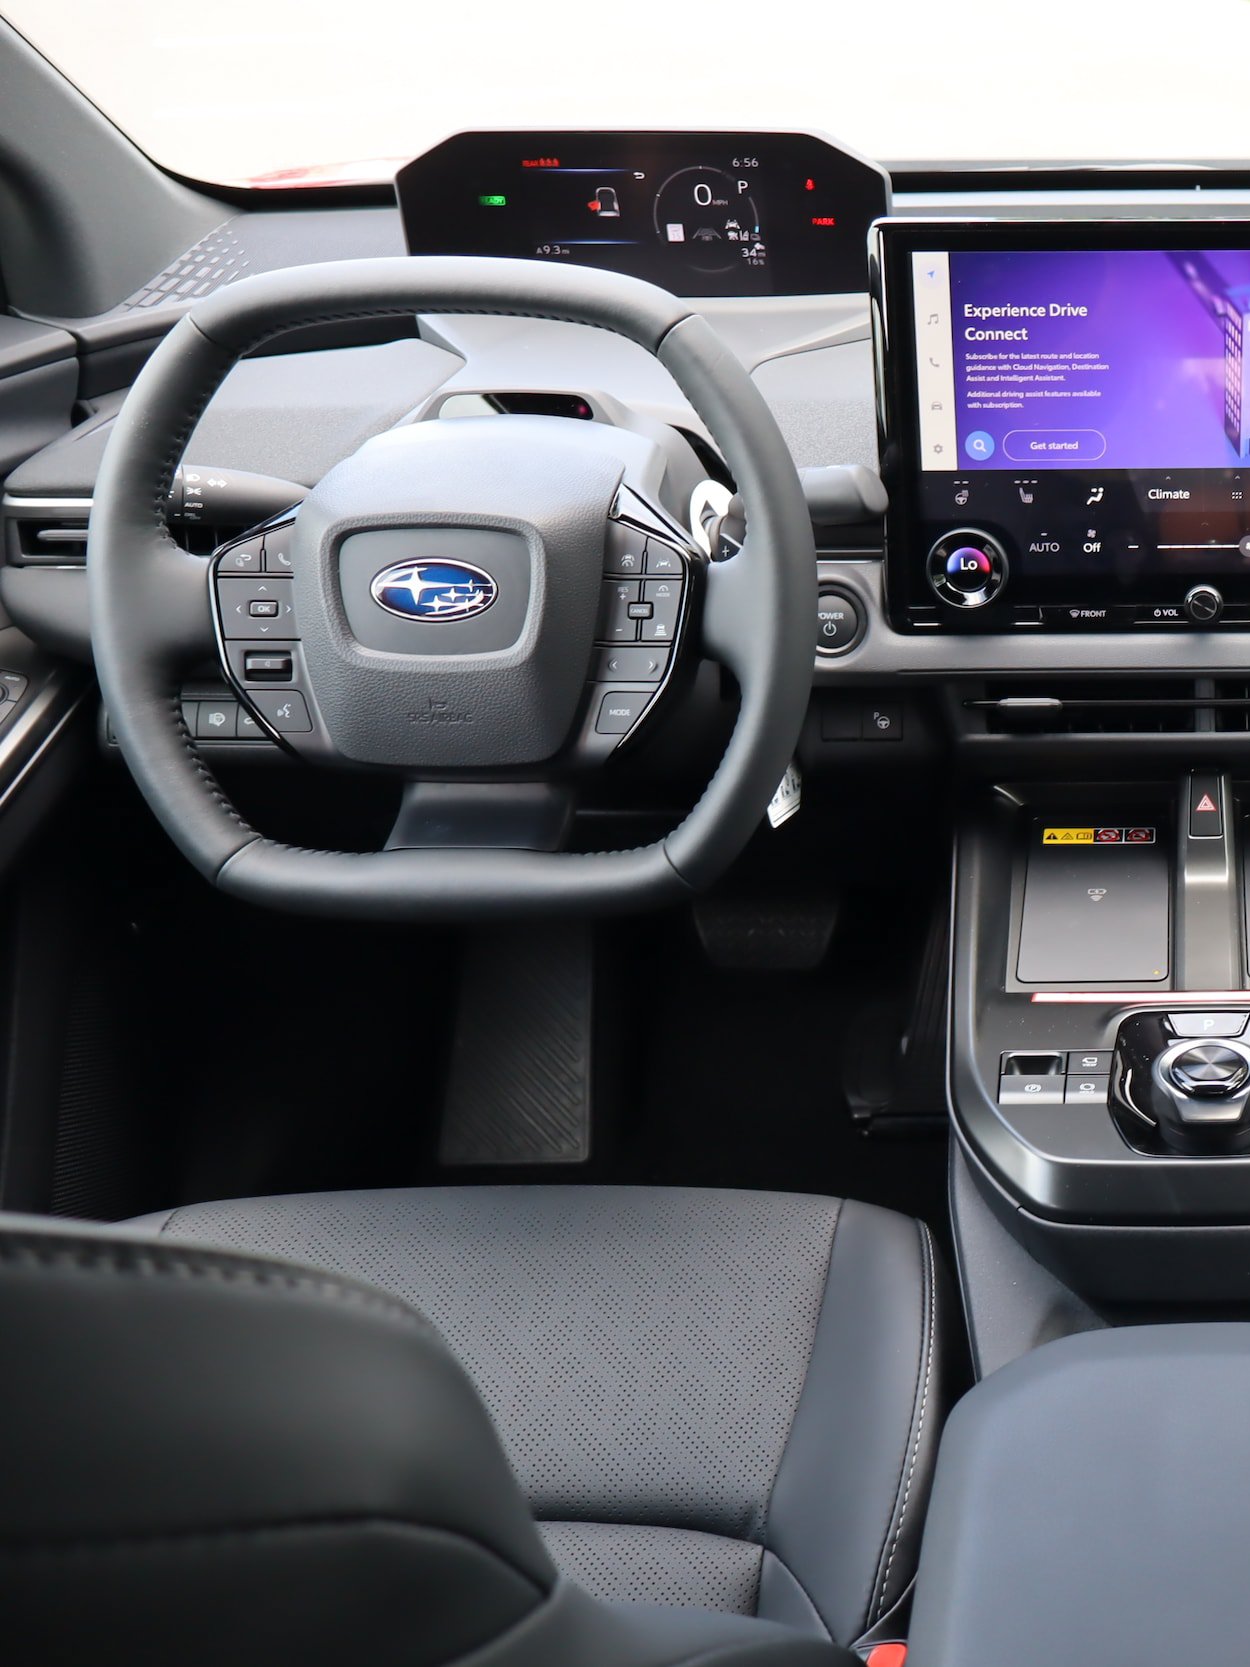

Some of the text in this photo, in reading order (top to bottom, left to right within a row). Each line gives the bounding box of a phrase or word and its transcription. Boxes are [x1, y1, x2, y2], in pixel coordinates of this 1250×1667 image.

[732, 158, 759, 167] 6:56
[738, 180, 748, 194] P
[694, 183, 712, 206] 0
[812, 217, 835, 226] PARK
[964, 303, 1088, 320] Experience Drive
[964, 327, 1028, 341] Connect
[1073, 352, 1099, 360] location
[966, 364, 996, 372] guidance
[1013, 363, 1033, 371] Cloud
[1034, 363, 1071, 372] Navigation,
[1072, 363, 1109, 371] Destination
[1000, 375, 1034, 383] Intelligent
[1001, 391, 1024, 399] driving
[1044, 390, 1071, 398] features
[983, 402, 1024, 410] subscription.
[1030, 441, 1079, 450] Get started
[1148, 489, 1190, 499] Climate
[1029, 542, 1060, 552] AUTO
[1083, 542, 1101, 553] Off
[960, 557, 978, 571] Lo
[257, 605, 270, 613] OK
[1162, 609, 1178, 617] VOL
[1080, 610, 1107, 618] FRONT
[1203, 1019, 1214, 1030] P
